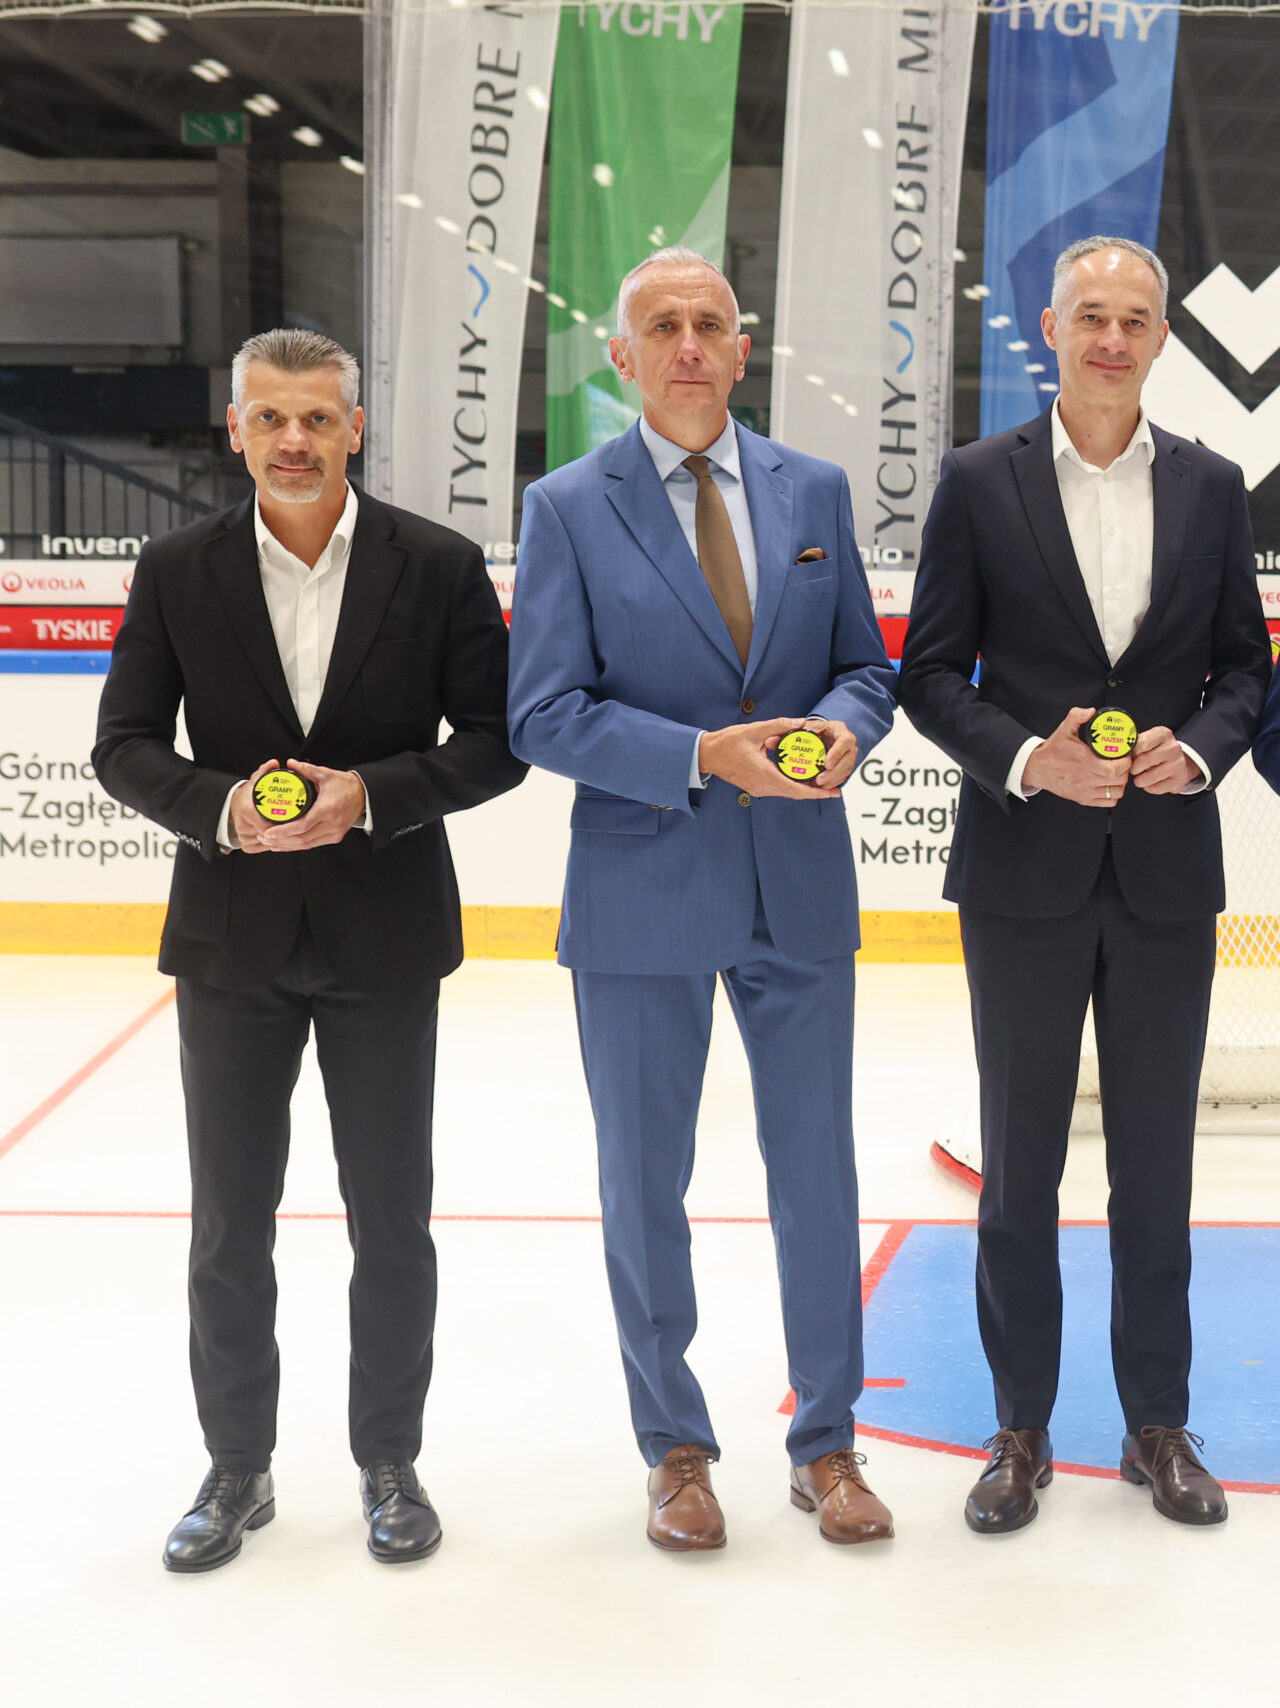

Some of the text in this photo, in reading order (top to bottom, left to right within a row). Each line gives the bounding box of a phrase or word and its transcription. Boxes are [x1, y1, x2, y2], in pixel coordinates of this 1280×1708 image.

[466, 42, 521, 254] DOBRE
[448, 321, 488, 514] TYCHY
[25, 578, 86, 591] VEOLIA
[31, 618, 113, 641] TYSKIE
